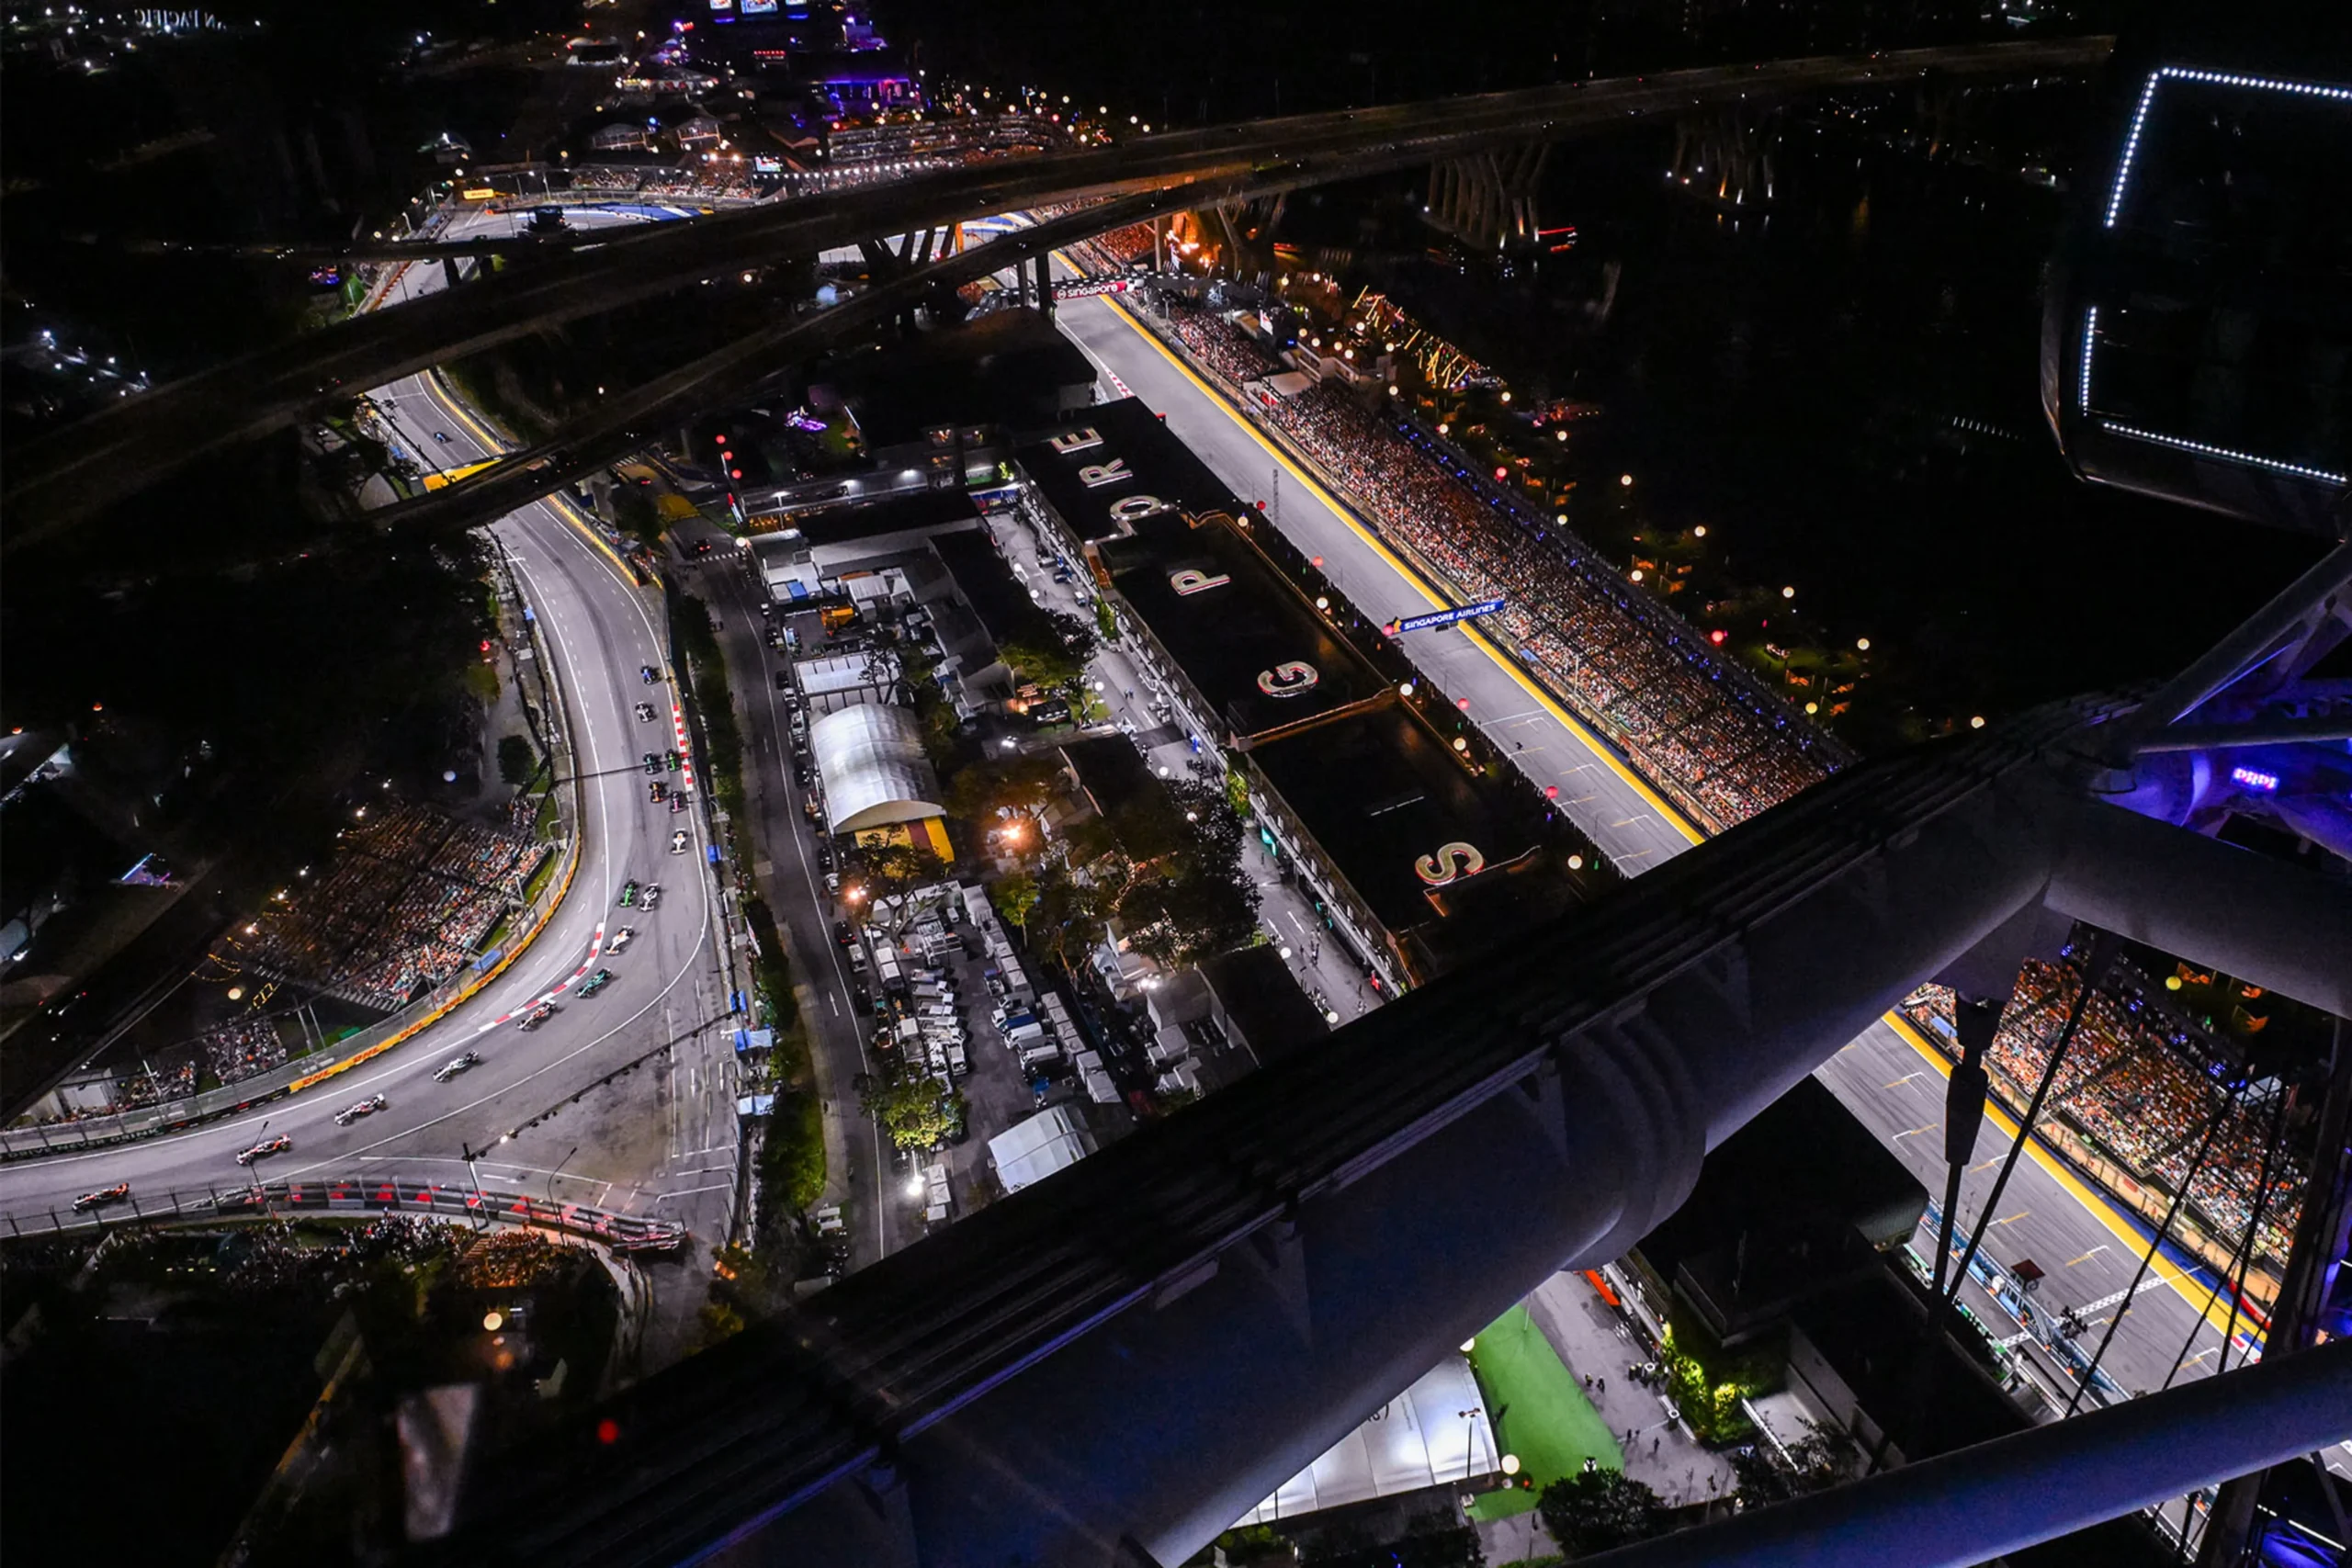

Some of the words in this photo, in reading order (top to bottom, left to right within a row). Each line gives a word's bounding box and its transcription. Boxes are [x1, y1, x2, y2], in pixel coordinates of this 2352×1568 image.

[1404, 613, 1454, 630] SINGAPORE
[1456, 604, 1496, 619] AIRLINES
[353, 1047, 380, 1064] DHL
[302, 1070, 332, 1085] DHL
[57, 1139, 105, 1152] NEVER
[109, 1128, 158, 1143] DRINK
